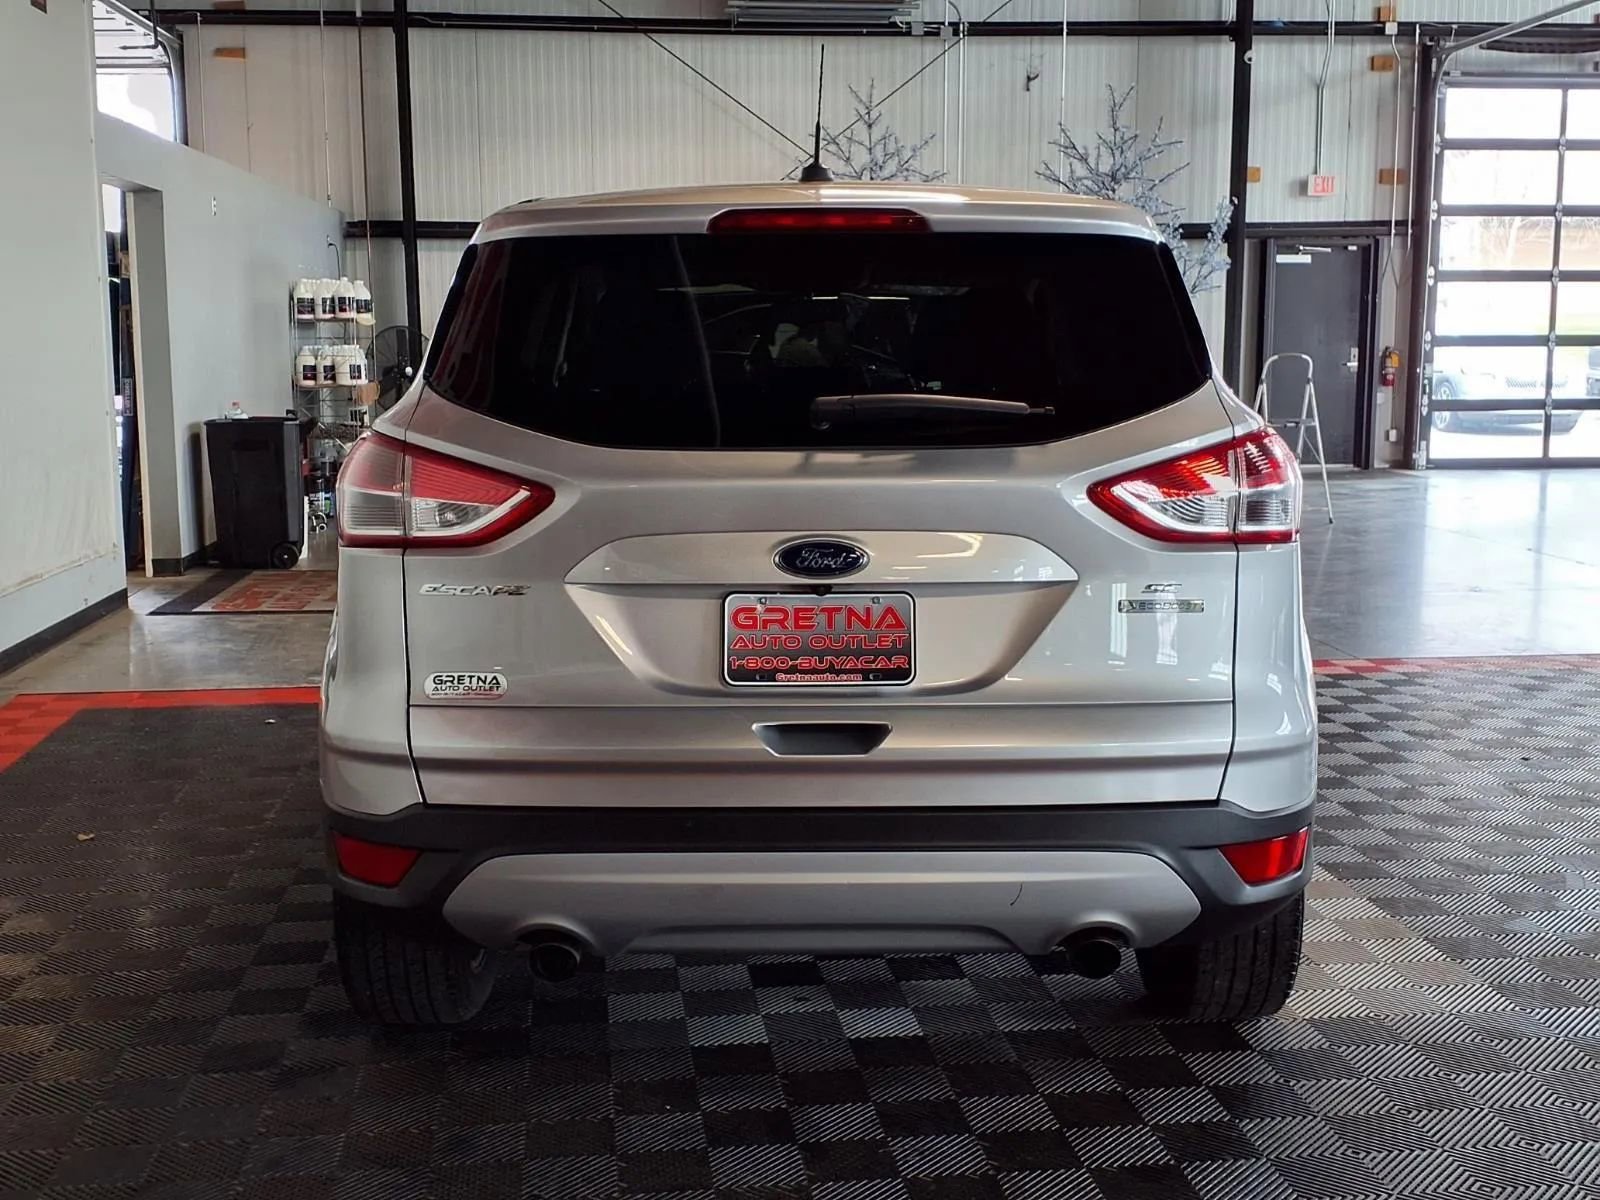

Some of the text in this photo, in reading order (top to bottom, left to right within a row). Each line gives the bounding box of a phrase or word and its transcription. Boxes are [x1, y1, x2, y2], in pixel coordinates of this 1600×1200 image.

[1313, 175, 1335, 193] EXIT
[795, 547, 848, 569] Ford
[419, 583, 531, 596] ESCAPE
[730, 604, 908, 632] GRETNA
[730, 633, 910, 650] AUTO OUTLET
[729, 656, 910, 670] 1-800-BUYACAR
[432, 674, 501, 685] GRETNA
[775, 673, 863, 682] Gretnaauto.com
